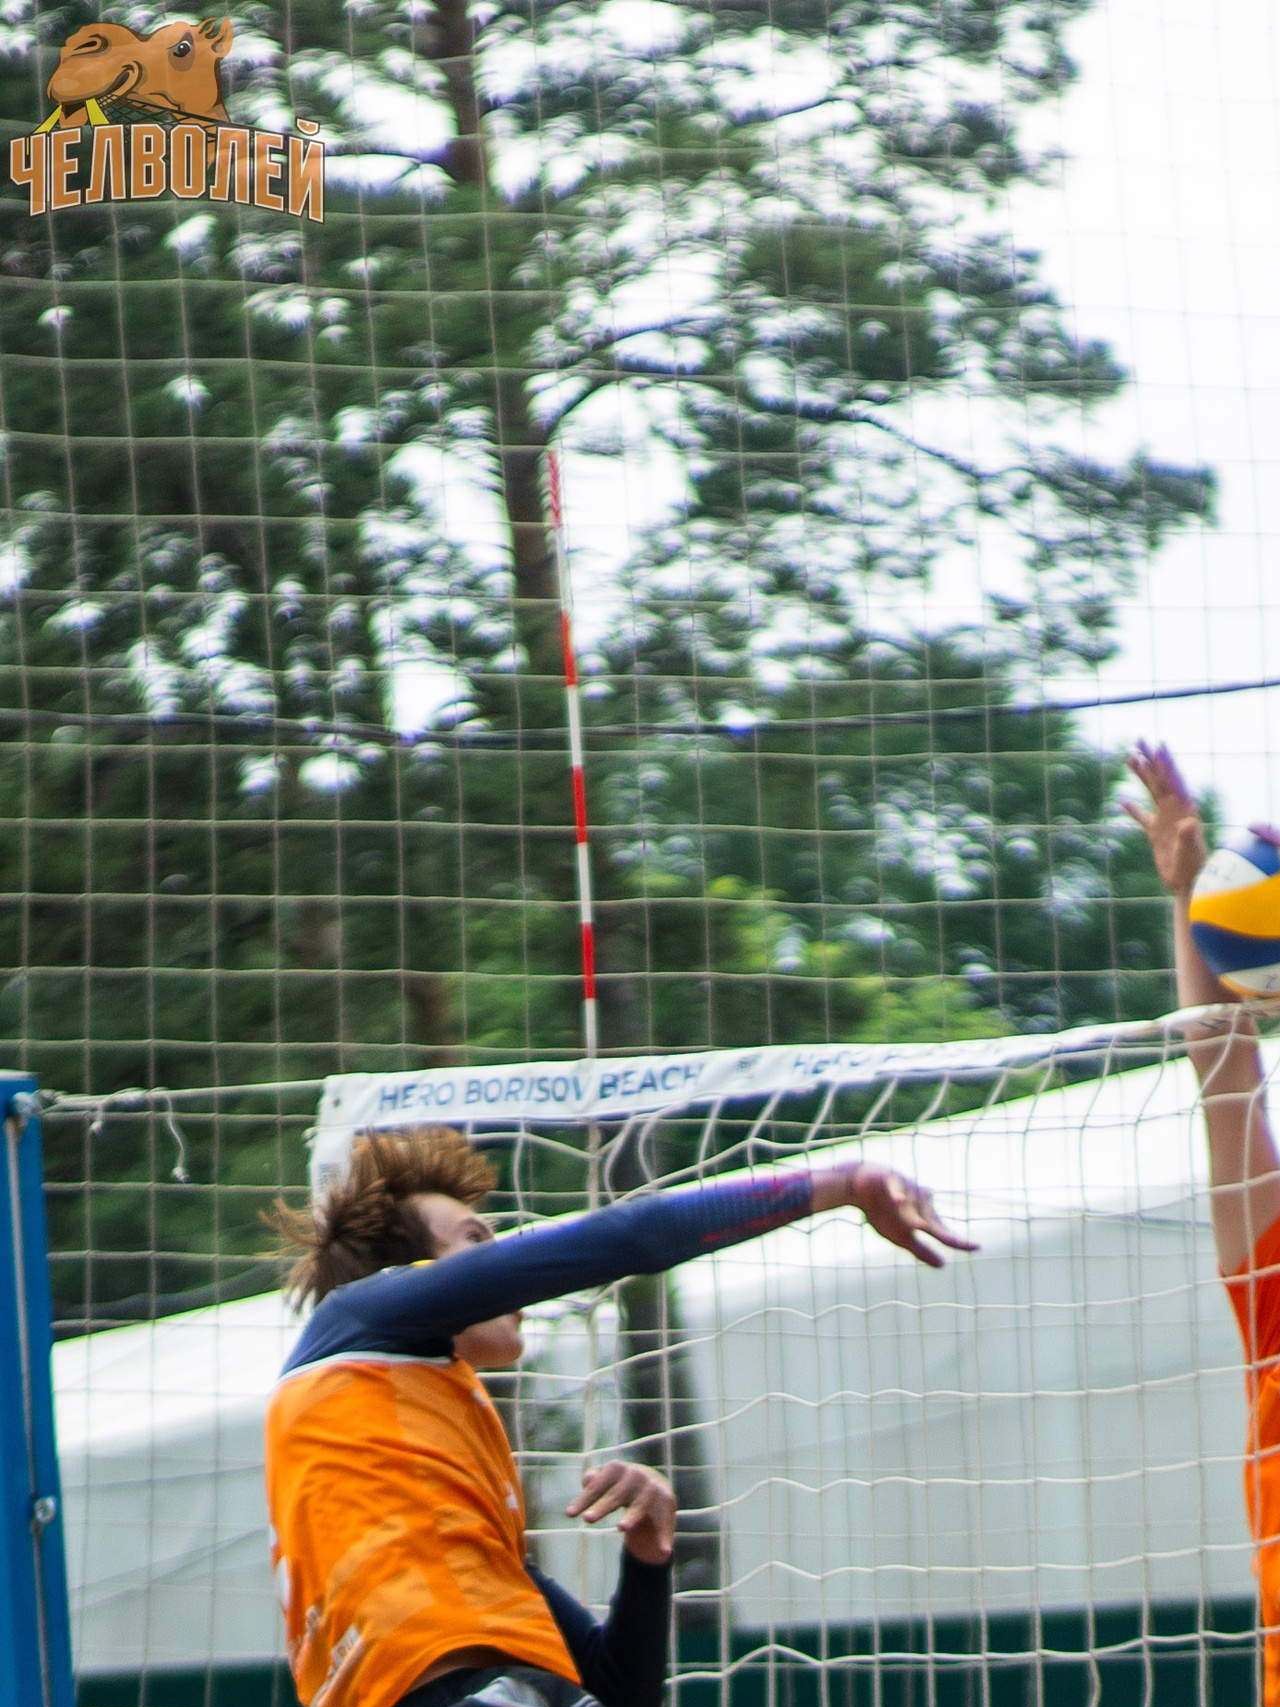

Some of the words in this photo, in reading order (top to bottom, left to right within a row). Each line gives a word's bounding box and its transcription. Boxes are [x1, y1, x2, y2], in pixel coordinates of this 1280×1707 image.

[378, 1082, 455, 1112] HERO
[463, 1075, 590, 1106] BORISOV
[599, 1062, 706, 1100] BEACH
